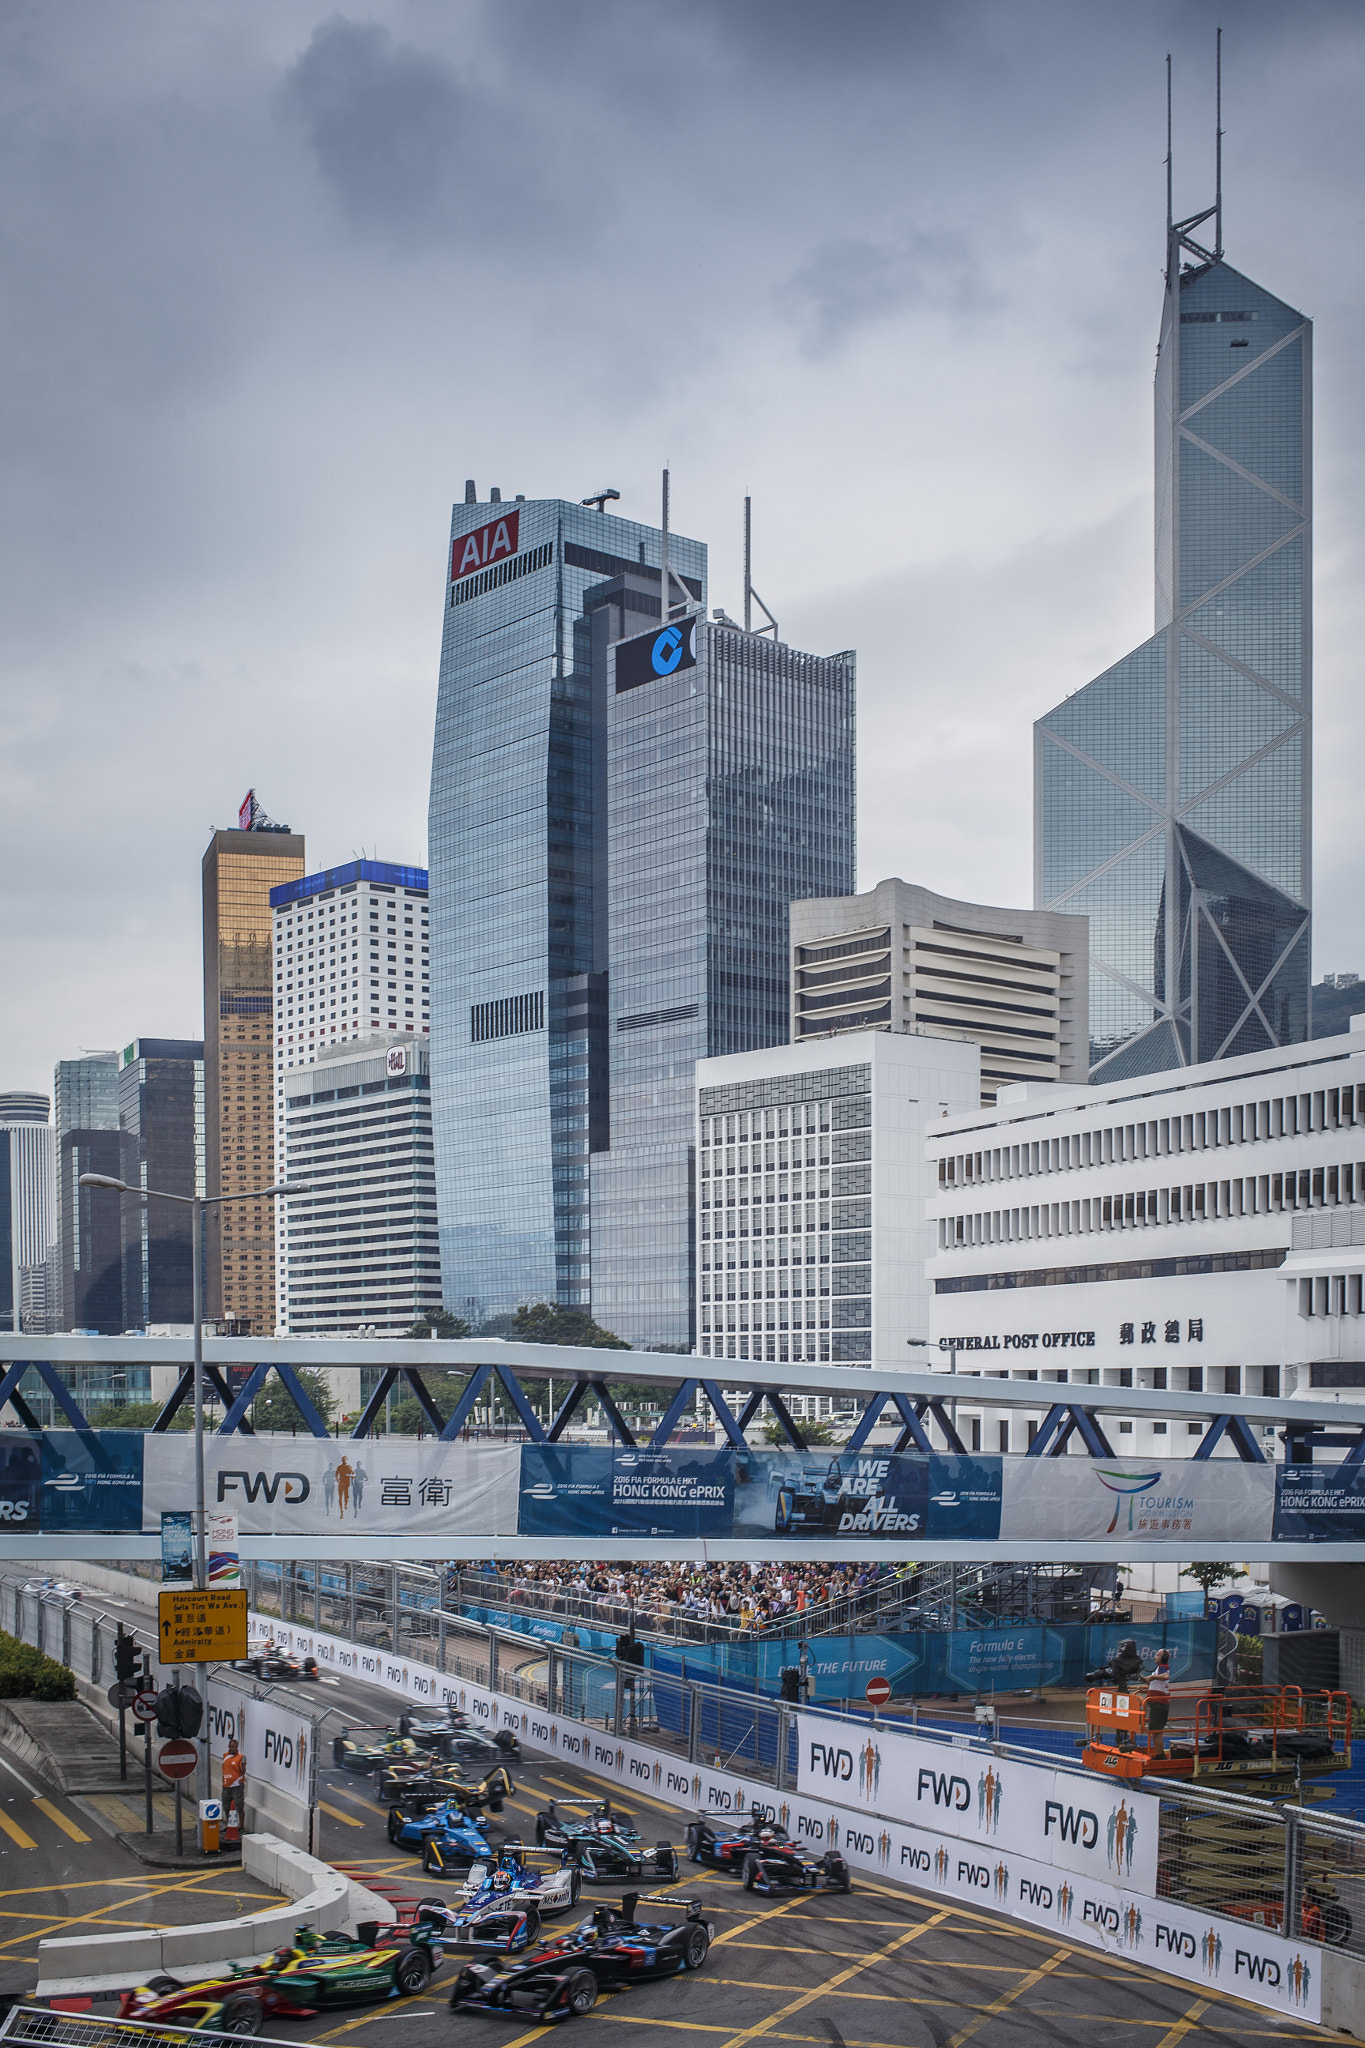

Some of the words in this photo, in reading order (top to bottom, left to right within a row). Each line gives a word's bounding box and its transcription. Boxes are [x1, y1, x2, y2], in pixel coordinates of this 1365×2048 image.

[459, 520, 512, 574] AIA
[939, 1335, 1000, 1351] GENERAL
[1003, 1333, 1039, 1349] POST
[1042, 1331, 1095, 1348] OFFICE
[1119, 1318, 1204, 1345] 郵政總局
[857, 1459, 890, 1477] WE
[217, 1470, 310, 1504] FWD
[613, 1475, 630, 1484] 2016
[631, 1476, 642, 1484] FIA
[643, 1476, 676, 1484] FORMULA
[682, 1477, 698, 1485] HKT
[837, 1478, 880, 1495] ARE
[380, 1475, 453, 1507] 富衛
[613, 1484, 649, 1497] HONG
[652, 1485, 687, 1498] KONG
[689, 1485, 725, 1498] ePRIX
[862, 1495, 899, 1513] ALL
[1140, 1497, 1194, 1509] TOURISM
[1280, 1496, 1309, 1507] HONG
[1311, 1496, 1338, 1507] KONG
[1338, 1496, 1365, 1507] ePRIX
[837, 1513, 920, 1531] DRIVERS
[1138, 1509, 1193, 1518] COMMISSION
[1137, 1518, 1193, 1530] 旅遊事務署
[223, 1602, 244, 1610] Ave.)
[970, 1639, 1015, 1653] Formula
[1017, 1638, 1025, 1650] E
[339, 1651, 352, 1667] FWD
[362, 1656, 375, 1673] FWD
[817, 1662, 839, 1675] THE
[841, 1659, 888, 1673] FUTURE
[387, 1666, 401, 1683] FWD
[414, 1675, 429, 1694] FWD
[472, 1699, 490, 1718] FWD
[504, 1711, 520, 1730] FWD
[532, 1722, 549, 1741] FWD
[265, 1728, 293, 1769] FWD
[562, 1733, 580, 1753] FWD
[594, 1746, 613, 1767] FWD
[811, 1742, 854, 1782] FWD
[1103, 1755, 1119, 1766] JLG
[1214, 1761, 1234, 1771] JLG
[630, 1758, 650, 1780] FWD
[667, 1772, 689, 1795] FWD
[917, 1768, 971, 1812] FWD
[708, 1786, 732, 1810] FWD
[797, 1815, 824, 1840] FWD
[1044, 1799, 1099, 1850] FWD
[846, 1829, 874, 1855] FWD
[900, 1845, 931, 1872] FWD
[957, 1860, 990, 1889] FWD
[543, 1896, 554, 1905] MS
[1019, 1879, 1053, 1910] FWD
[1083, 1899, 1120, 1933] FWD
[1155, 1923, 1197, 1960] FWD
[1234, 1948, 1281, 1987] FWD
